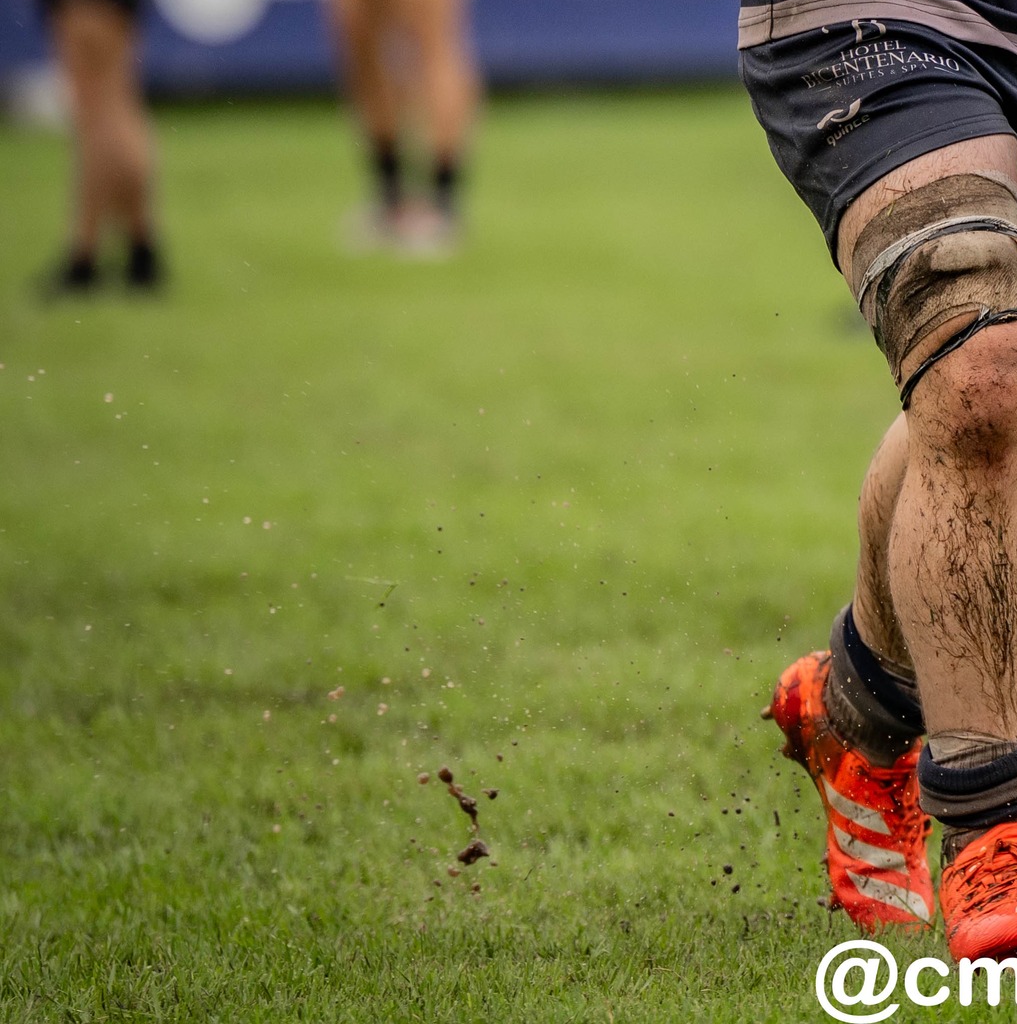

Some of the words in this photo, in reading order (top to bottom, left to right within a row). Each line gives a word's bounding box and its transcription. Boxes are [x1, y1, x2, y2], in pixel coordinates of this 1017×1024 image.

[840, 40, 907, 63] HOTEL
[801, 50, 960, 89] BICENTENARIO
[835, 70, 885, 88] SUITES
[826, 113, 871, 147] quince
